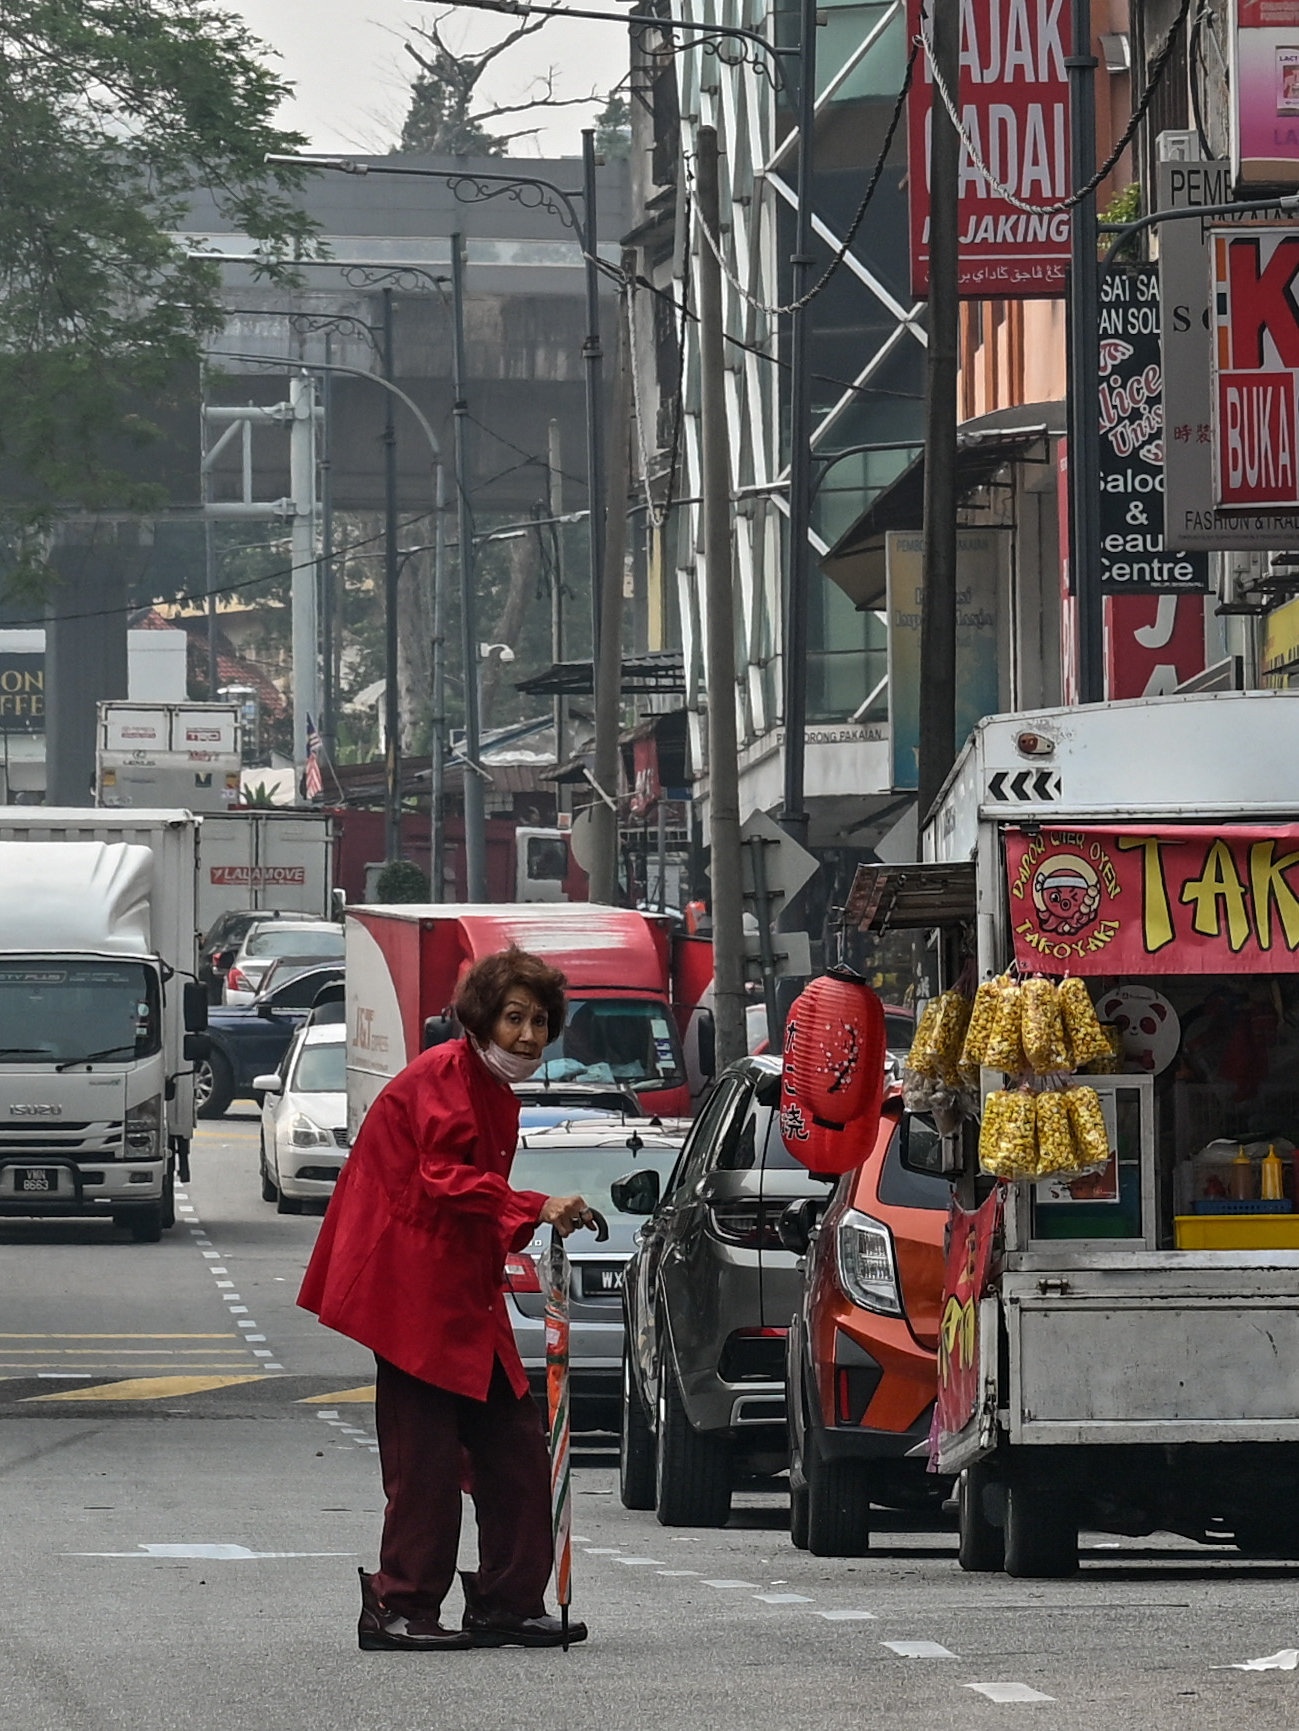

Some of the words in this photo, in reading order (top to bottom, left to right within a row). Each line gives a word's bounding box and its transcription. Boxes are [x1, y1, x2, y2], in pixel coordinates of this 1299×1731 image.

[924, 0, 1069, 84] AJAK
[924, 103, 1066, 199] ADAI
[922, 214, 1070, 245] JAKING
[1099, 364, 1162, 434] lice
[1227, 386, 1292, 489] BUKA
[1125, 501, 1149, 526] &
[224, 867, 304, 881] LALAMOVE
[1117, 836, 1299, 953] TAK
[1015, 918, 1121, 959] TAKOYAKI
[9, 1103, 62, 1116] ISUZU
